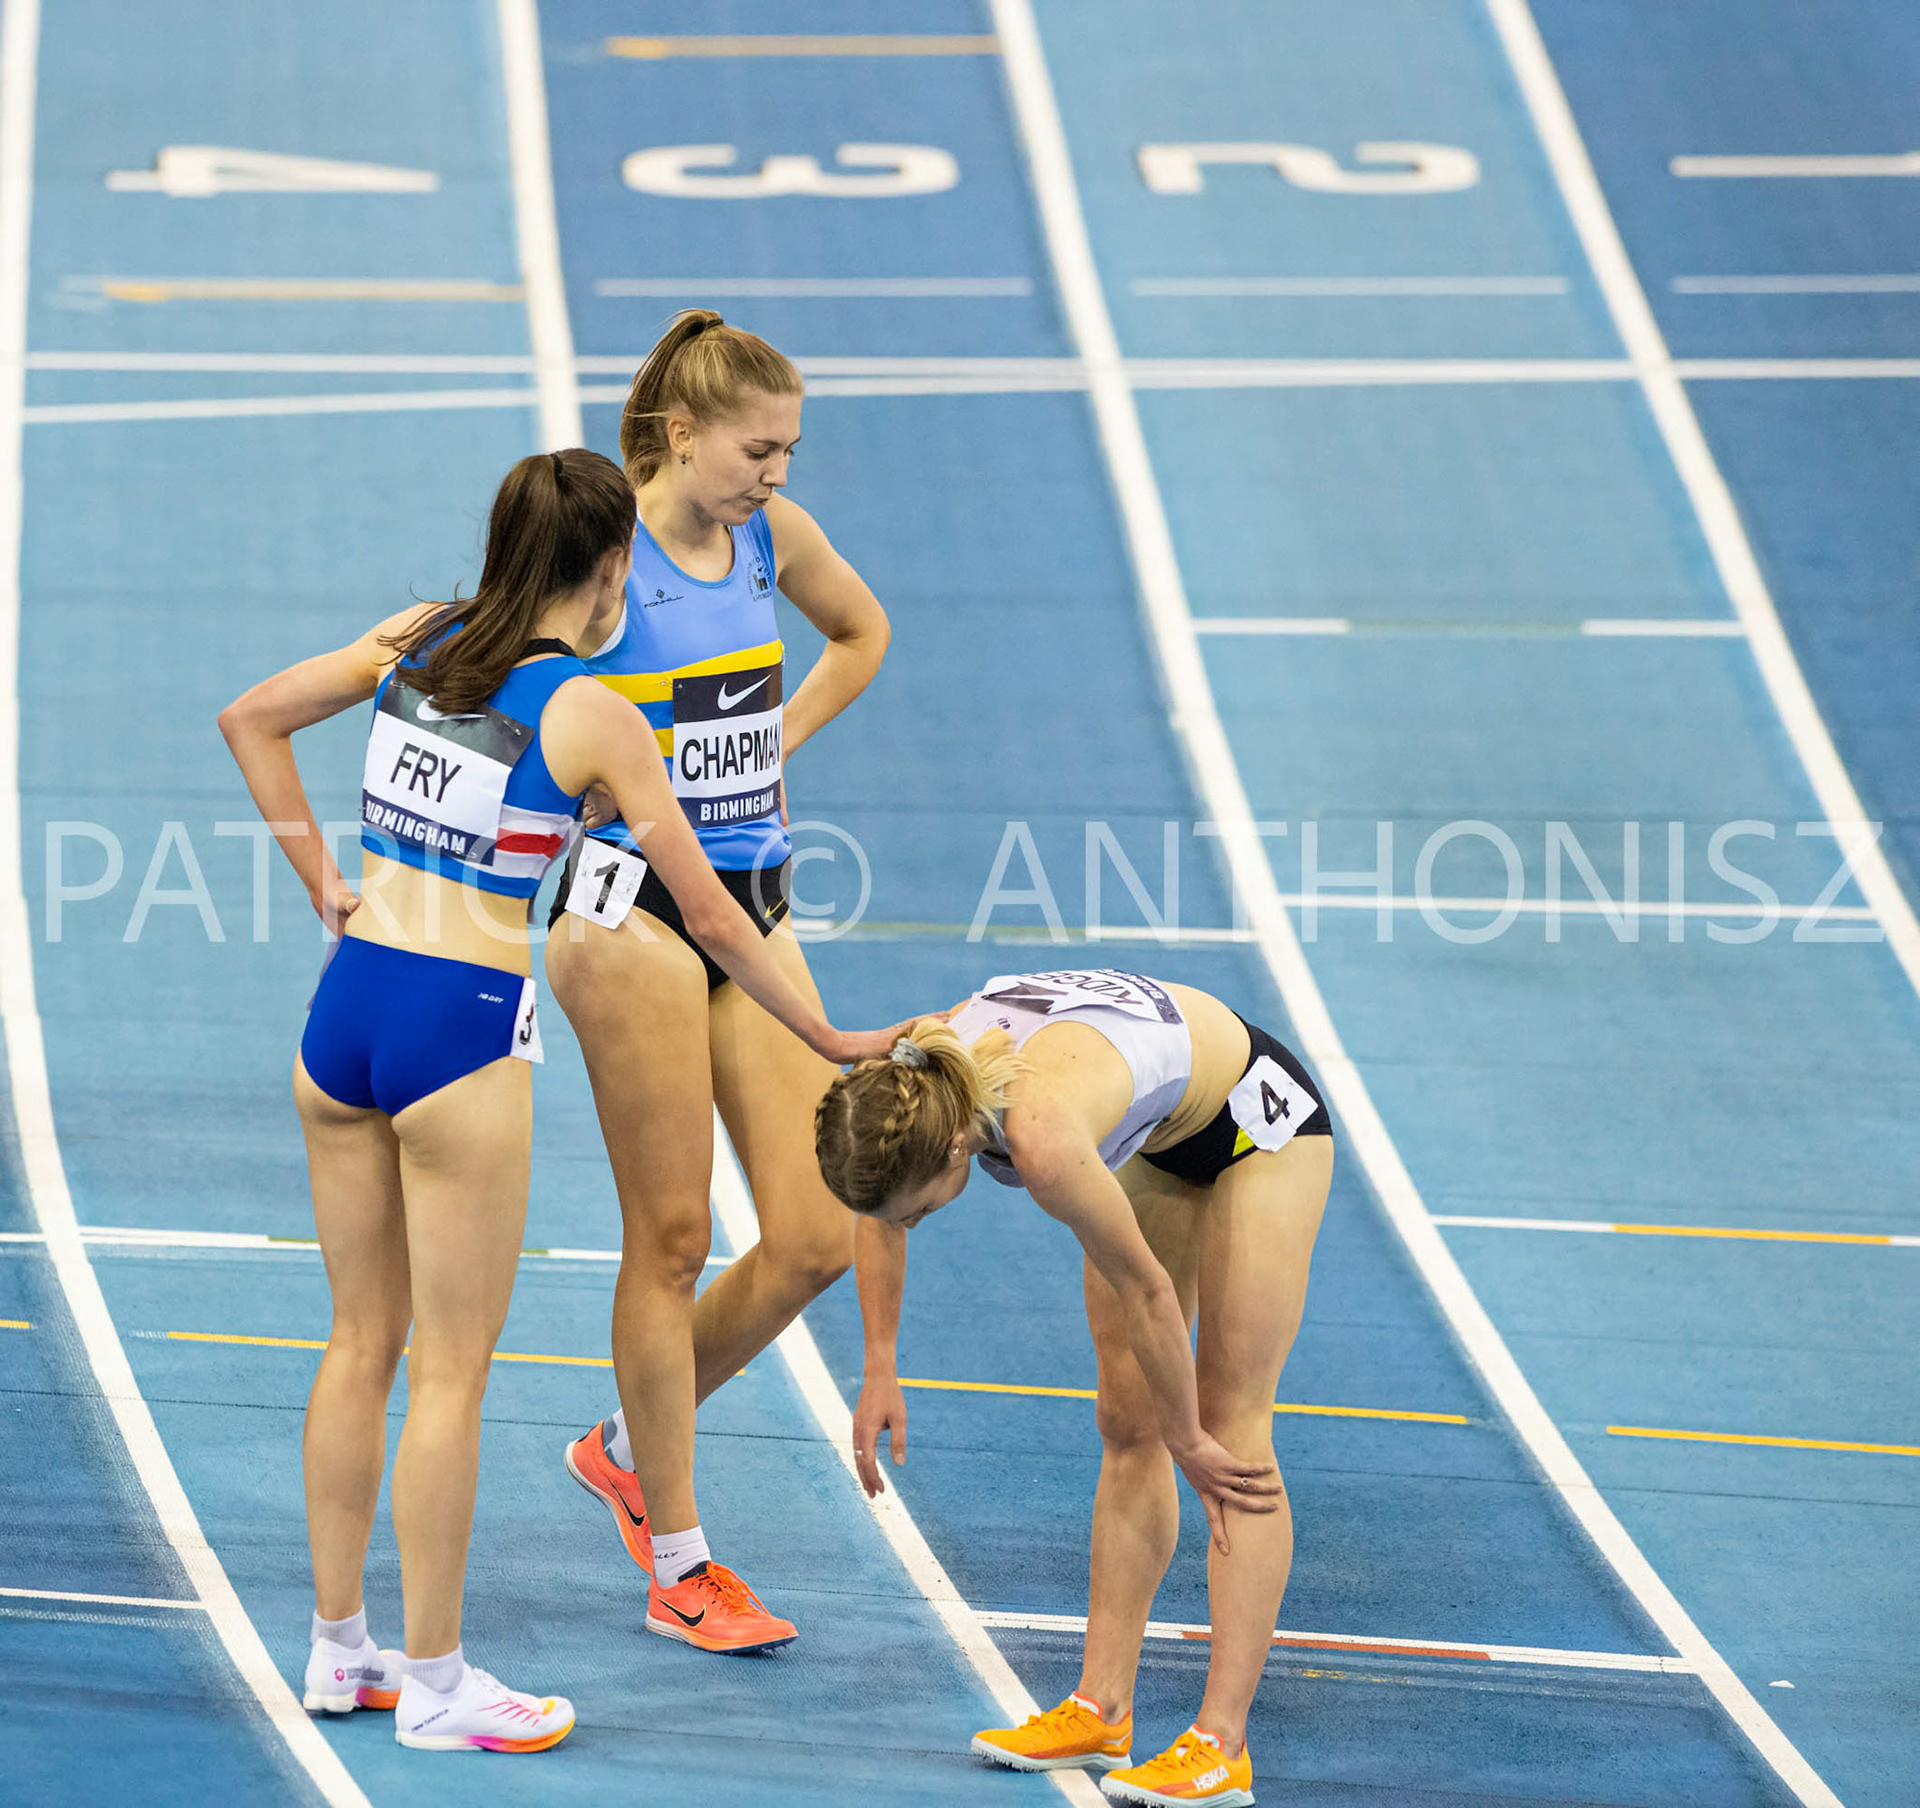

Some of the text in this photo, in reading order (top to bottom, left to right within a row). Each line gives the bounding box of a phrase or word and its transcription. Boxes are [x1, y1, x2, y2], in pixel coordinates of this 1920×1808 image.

[105, 145, 439, 198] 4
[622, 142, 958, 199] 3
[1137, 141, 1480, 195] 2
[390, 742, 462, 803] FRY
[680, 721, 781, 782] CHAPMAN
[700, 789, 775, 821] BIRMINGHAM
[594, 860, 621, 914] 1
[1021, 971, 1144, 1006] KIDGE
[1260, 1080, 1290, 1125] 4
[1192, 1765, 1230, 1792] HOKA
